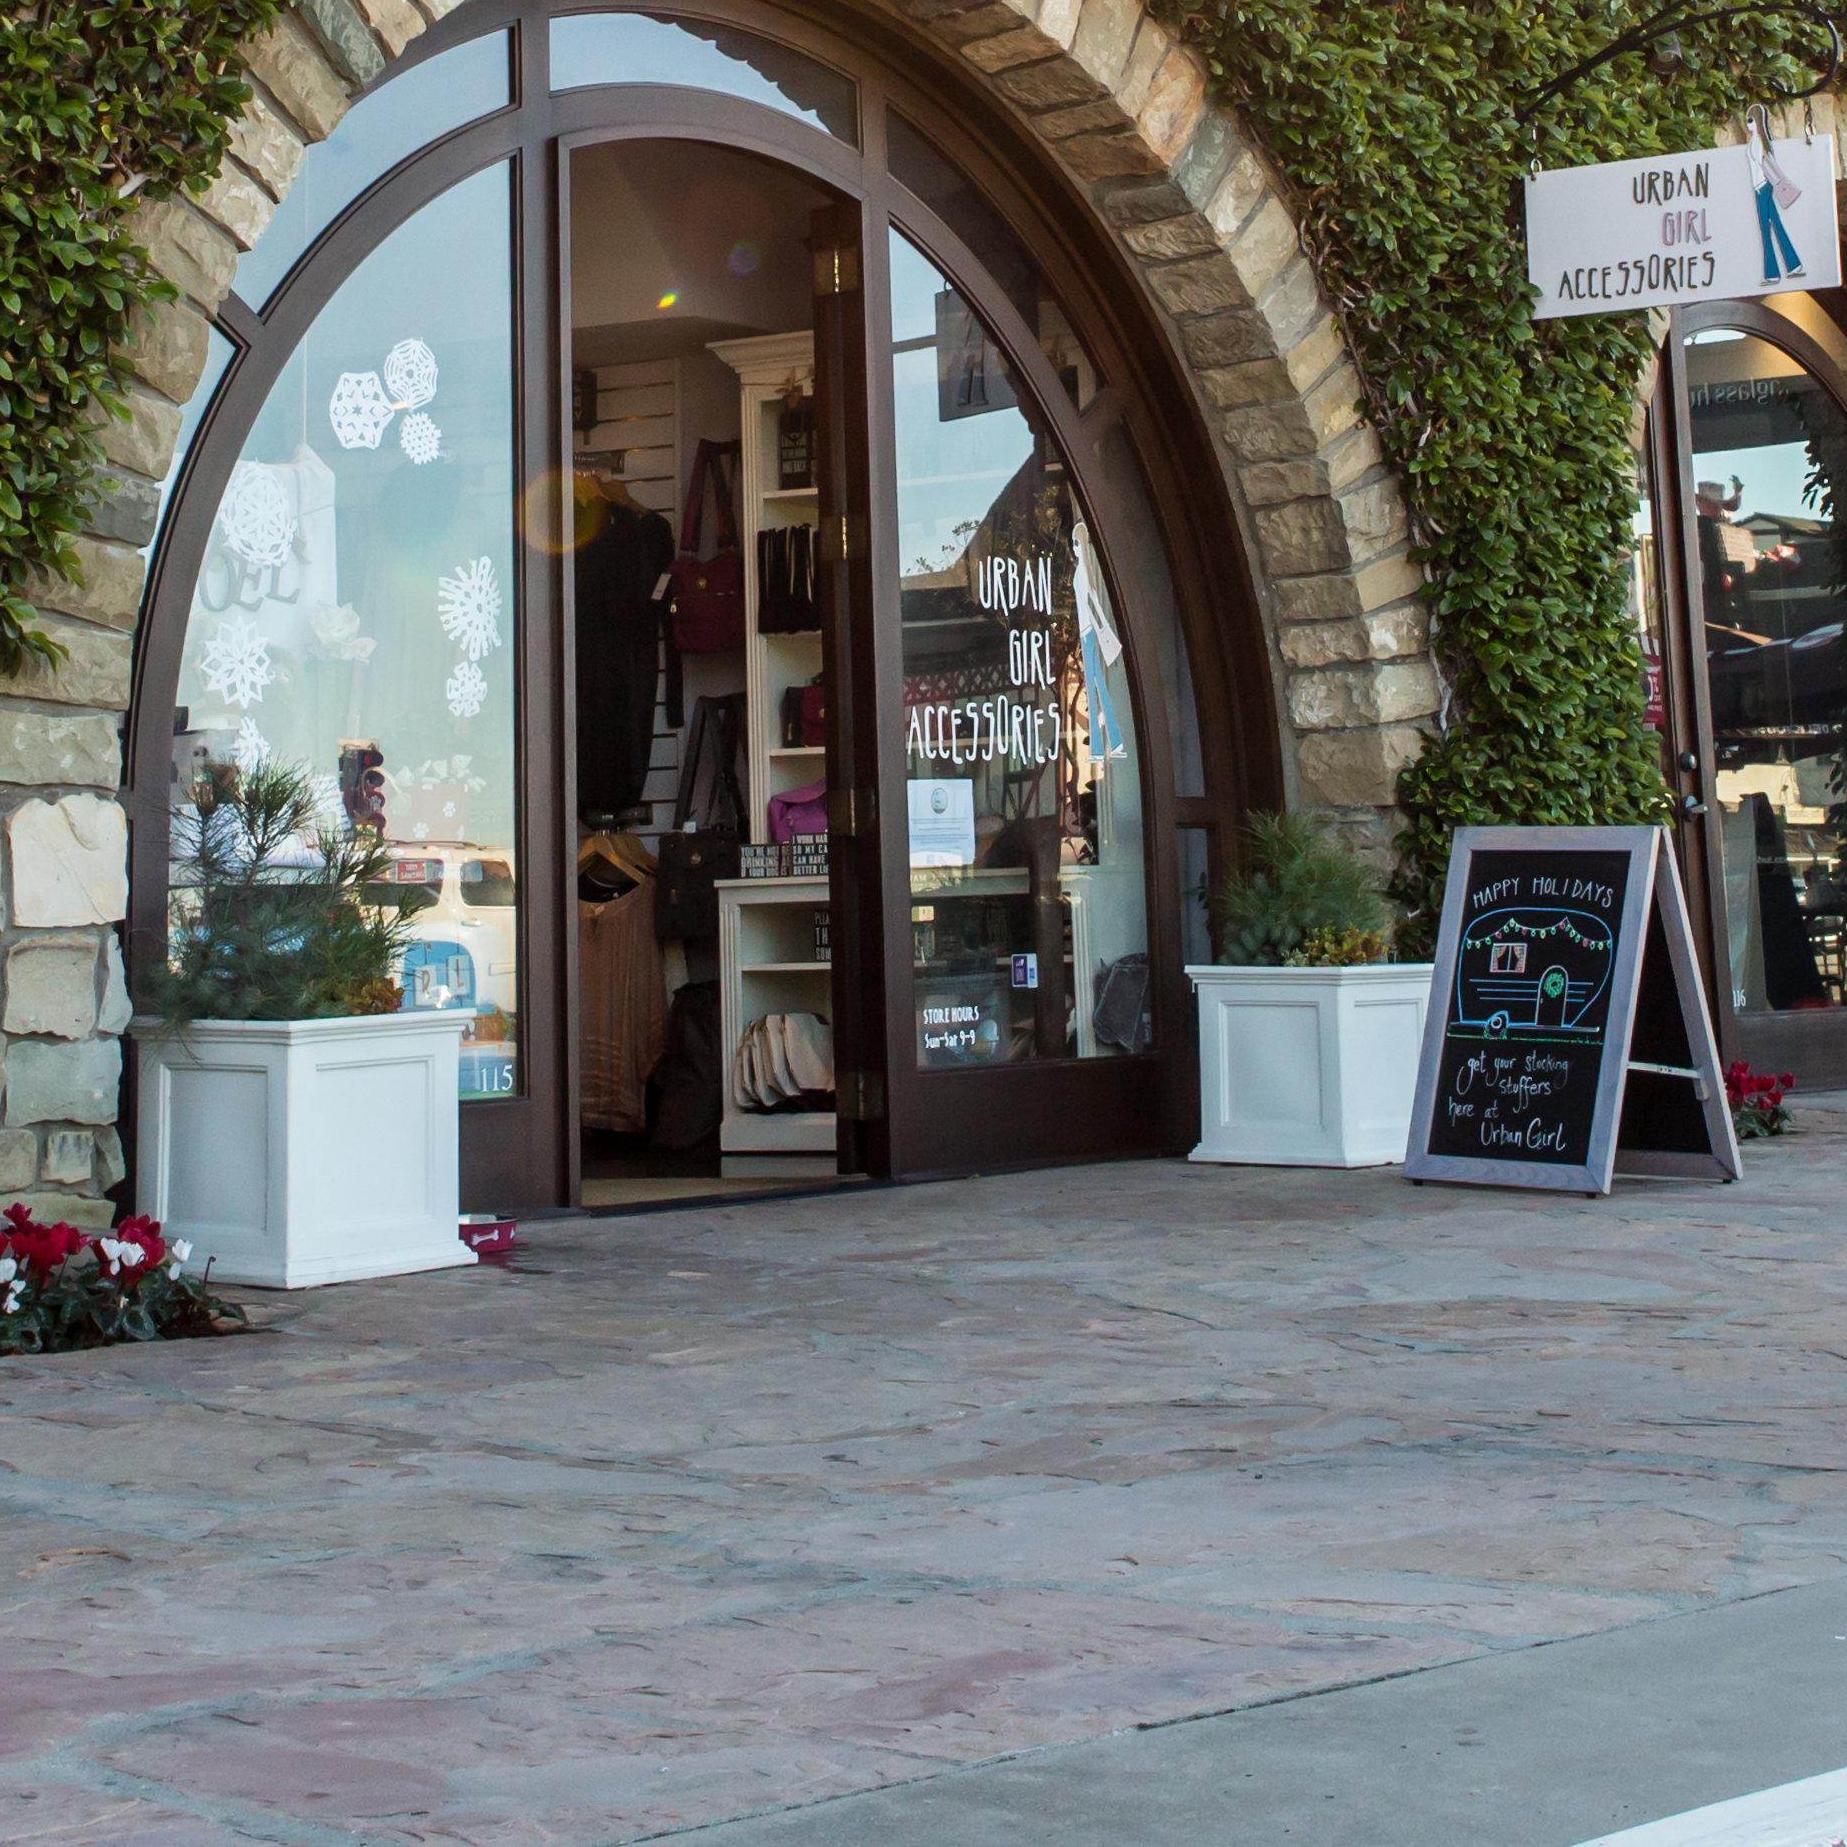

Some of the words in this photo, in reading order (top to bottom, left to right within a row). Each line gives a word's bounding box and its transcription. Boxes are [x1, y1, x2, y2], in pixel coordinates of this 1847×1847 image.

[1633, 163, 1709, 206] URBAN
[1662, 208, 1713, 246] GIRL
[1558, 251, 1715, 301] ACCESSORIES
[979, 556, 1052, 616] URBAN
[1009, 629, 1056, 690] GIRL
[908, 695, 1061, 765] ACCESSORIES
[1473, 877, 1521, 909] HAPPY
[1532, 876, 1614, 908] HOLIDAYS
[923, 1007, 950, 1024] STORE
[951, 1006, 979, 1023] HOURS
[959, 1029, 976, 1046] 9-9
[481, 1065, 514, 1093] 115
[1456, 1050, 1486, 1095] get
[1485, 1058, 1517, 1087] your
[1448, 1096, 1474, 1127] here
[1484, 1099, 1499, 1118] at
[1480, 1121, 1522, 1147] Urban
[1526, 1117, 1566, 1152] Girl
